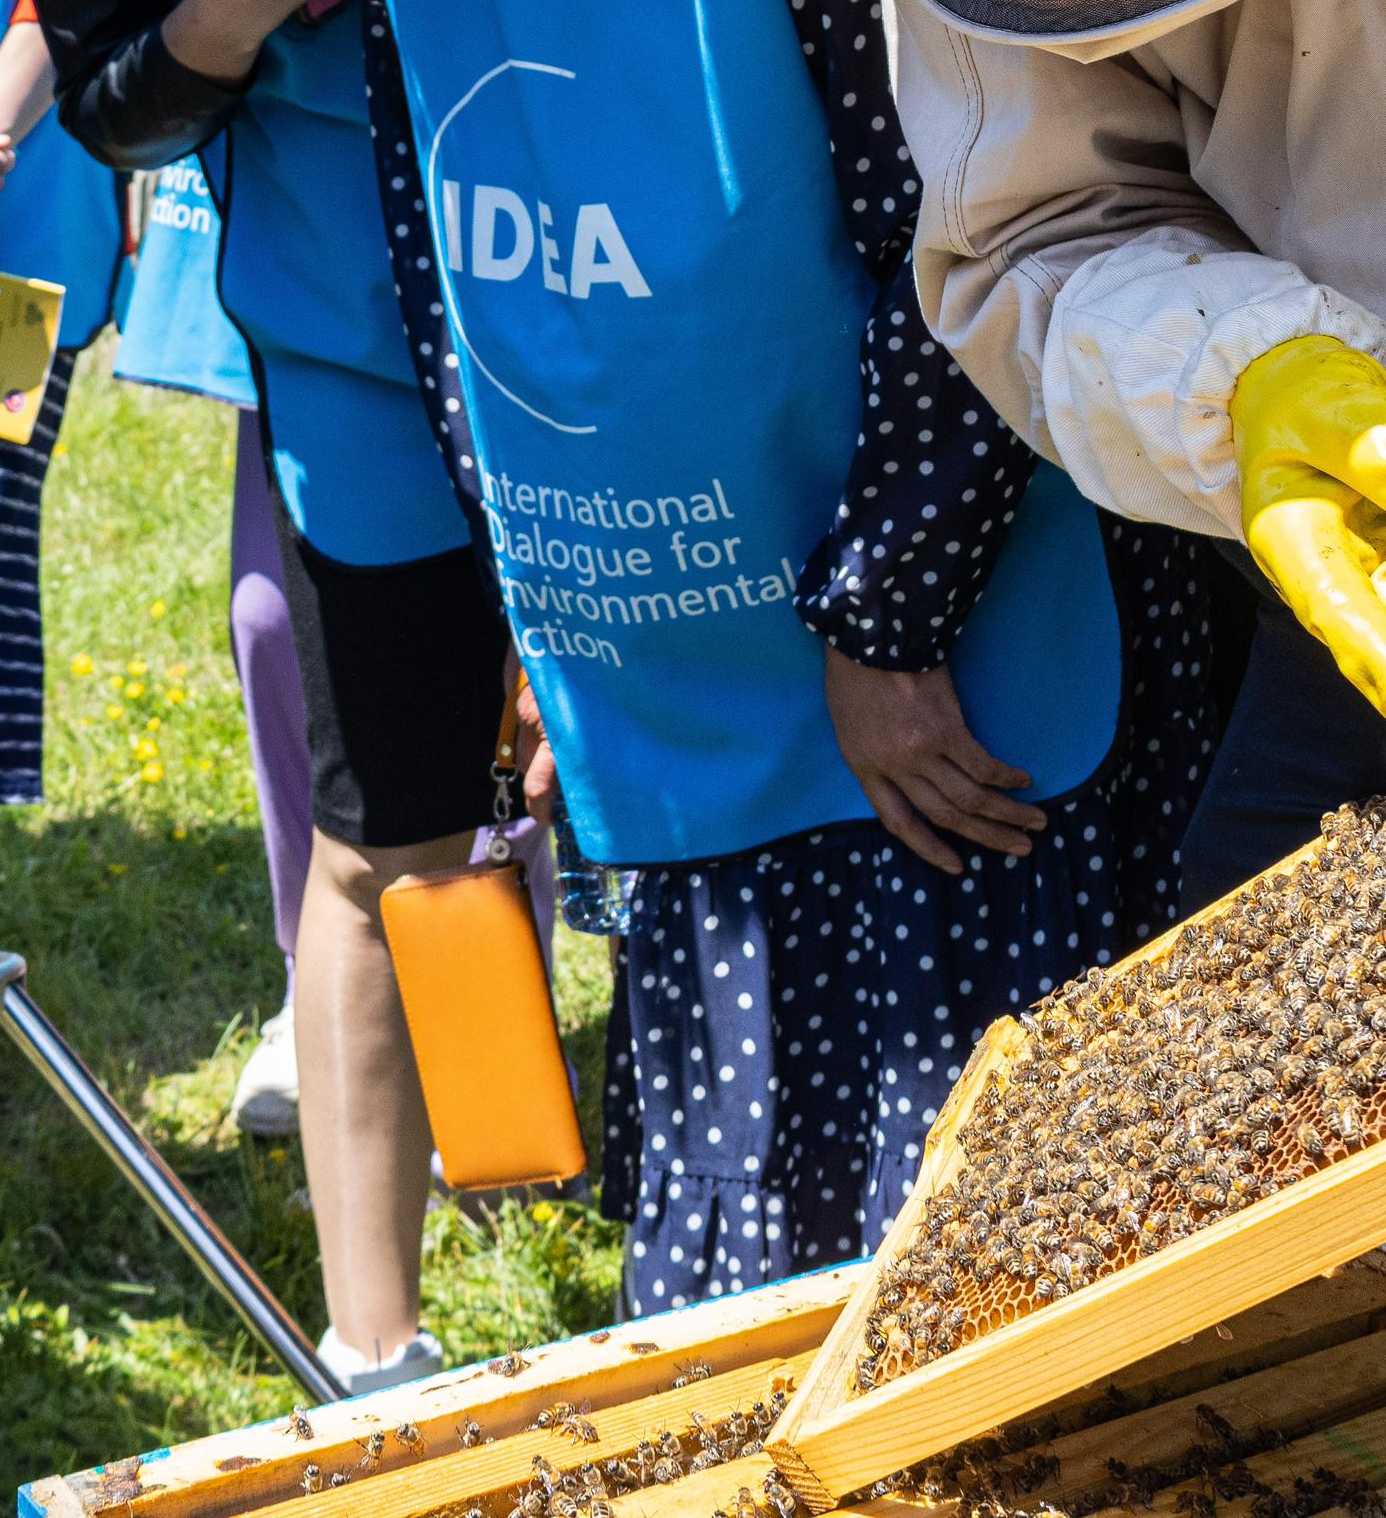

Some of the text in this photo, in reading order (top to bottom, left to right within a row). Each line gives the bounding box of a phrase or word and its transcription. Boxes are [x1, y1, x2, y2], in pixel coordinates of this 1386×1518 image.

[442, 179, 653, 300] IDEA
[487, 505, 741, 586] Dialogue for
